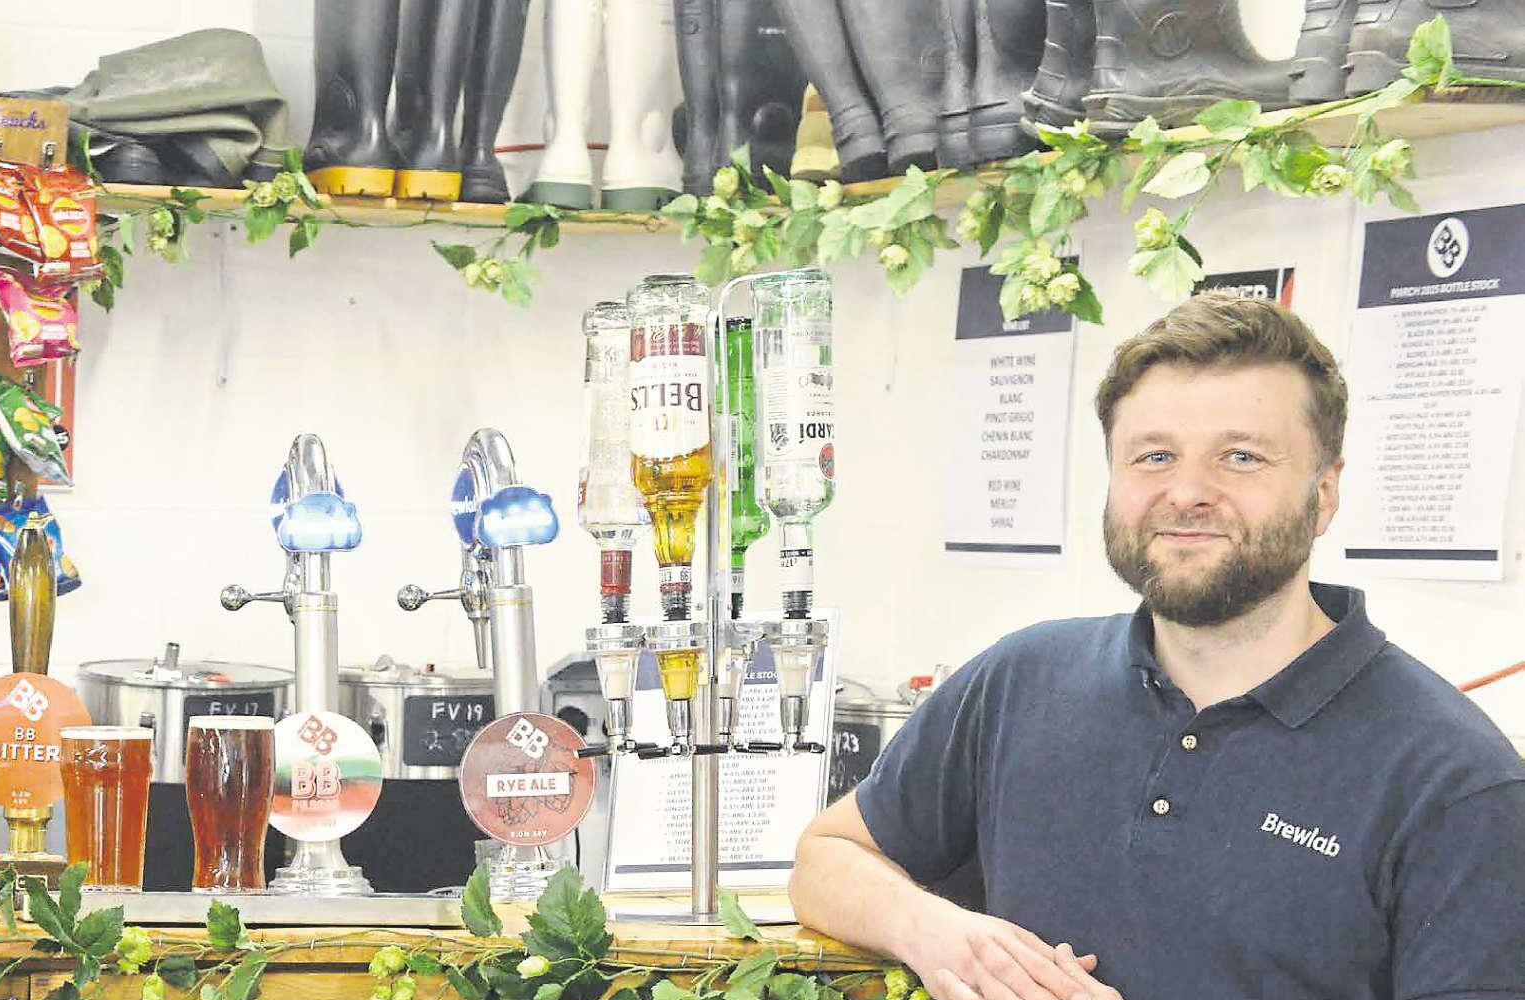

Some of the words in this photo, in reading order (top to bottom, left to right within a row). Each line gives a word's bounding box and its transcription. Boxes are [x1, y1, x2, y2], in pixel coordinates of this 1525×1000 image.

[431, 702, 460, 720] FV
[466, 702, 484, 721] 19
[15, 727, 36, 741] BB
[292, 762, 341, 799] BB
[497, 779, 526, 792] RYE
[530, 778, 556, 791] ALE
[1260, 812, 1341, 858] Brewlab
